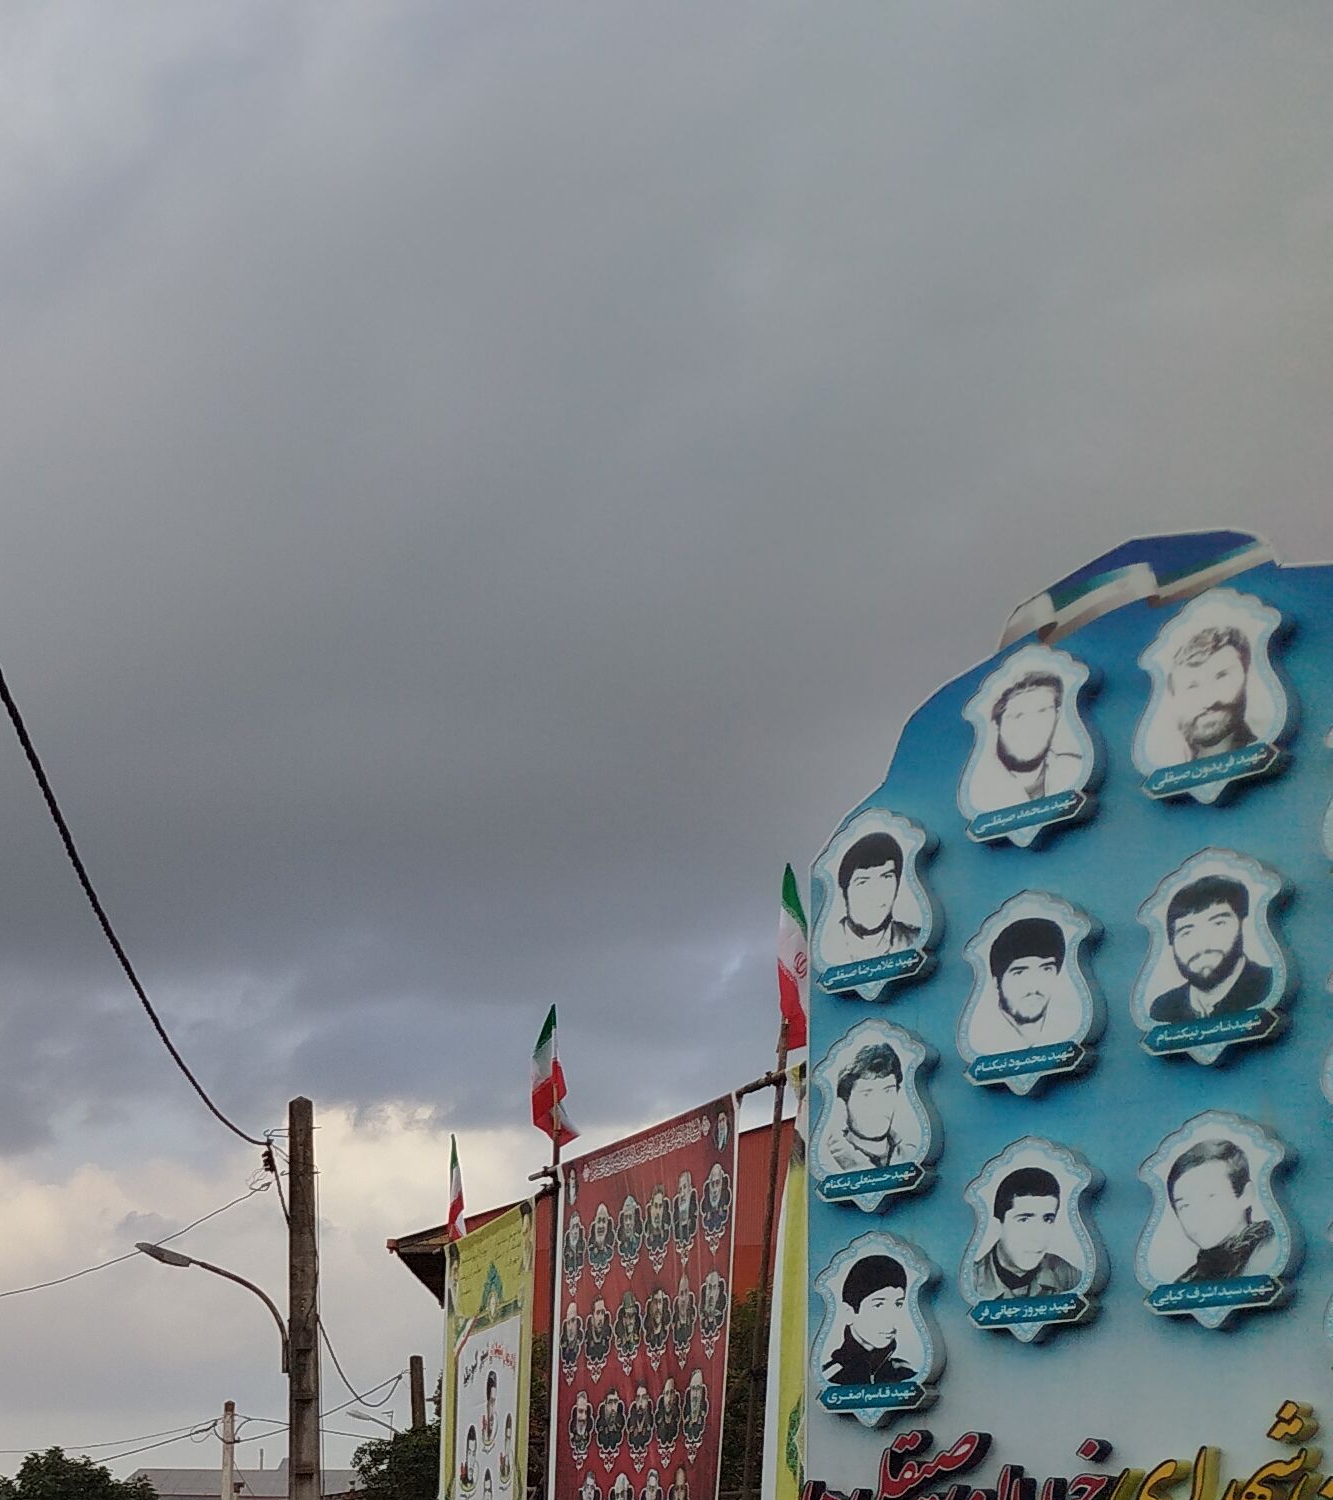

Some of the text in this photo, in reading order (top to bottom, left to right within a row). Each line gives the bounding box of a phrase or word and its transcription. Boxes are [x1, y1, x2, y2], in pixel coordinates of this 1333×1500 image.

[1016, 803, 1050, 820] محمد
[823, 954, 921, 986] شهید غلامرضا صیقلی
[1155, 1015, 1263, 1044] شهید ناصر نیکنام
[974, 1047, 1076, 1075] شهید محمود نیکنام
[823, 1166, 917, 1192] شهید حسینعلی نیکنام
[1185, 1285, 1217, 1303] اشرف
[1215, 1284, 1242, 1299] سید
[1241, 1281, 1275, 1297] شهید
[978, 1300, 1077, 1322] شهید بهروز جهانی فر
[826, 1386, 917, 1405] شهید قاسم اصغری
